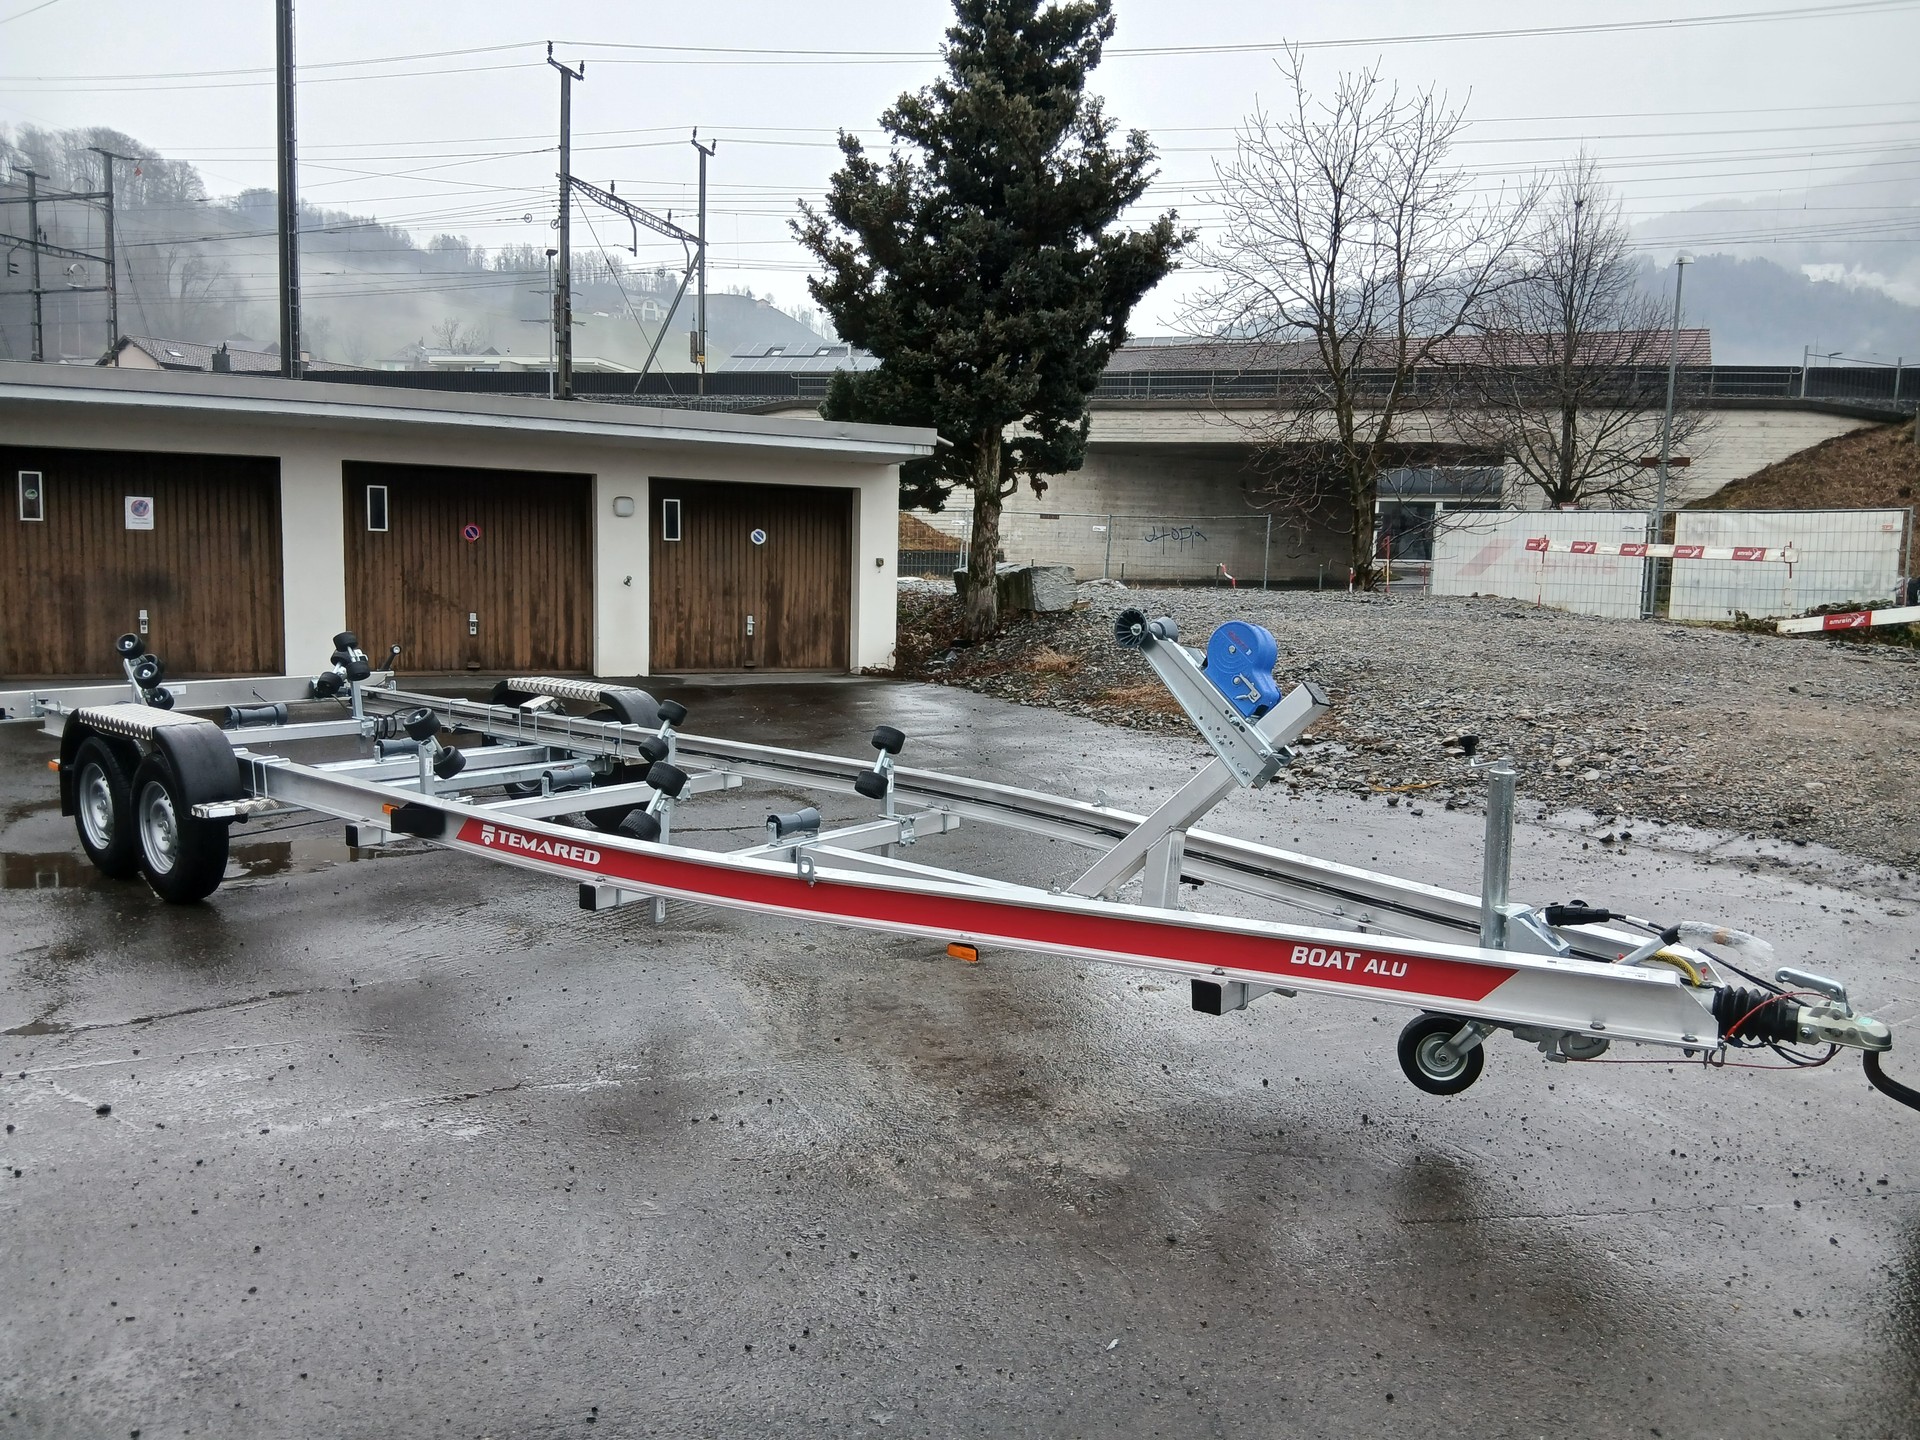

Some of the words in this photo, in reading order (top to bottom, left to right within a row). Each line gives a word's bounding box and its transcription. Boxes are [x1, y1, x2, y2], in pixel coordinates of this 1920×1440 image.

[498, 829, 600, 865] TEMARED
[1290, 945, 1361, 971] BOAT
[1363, 958, 1408, 977] ALU
